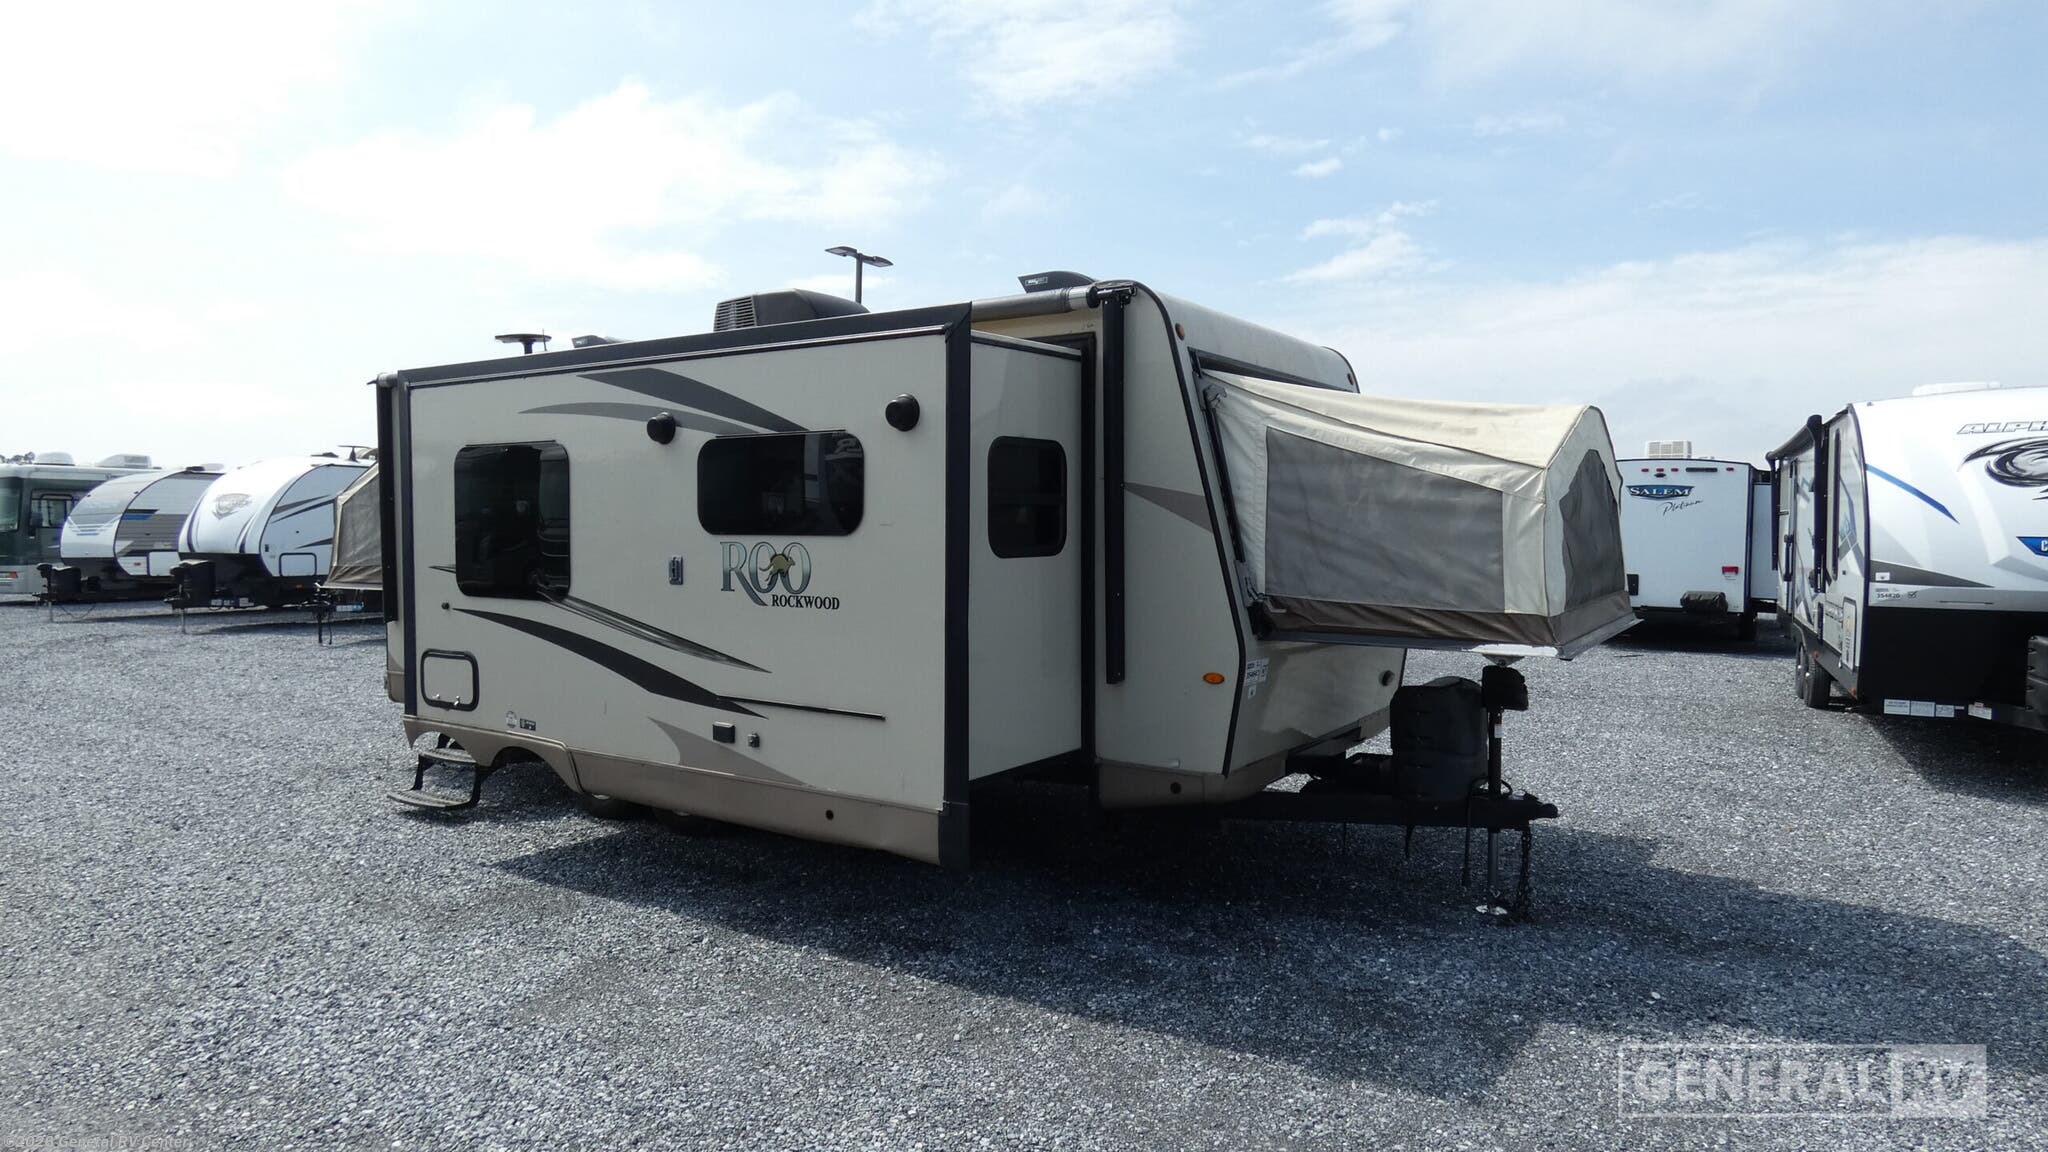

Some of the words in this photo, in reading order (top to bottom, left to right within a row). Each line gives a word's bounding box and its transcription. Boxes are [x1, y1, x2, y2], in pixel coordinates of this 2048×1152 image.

[1630, 487, 1689, 495] SALEM
[1657, 500, 1703, 516] Platinum
[720, 541, 812, 606] ROO
[771, 594, 840, 610] ROCKWOOD
